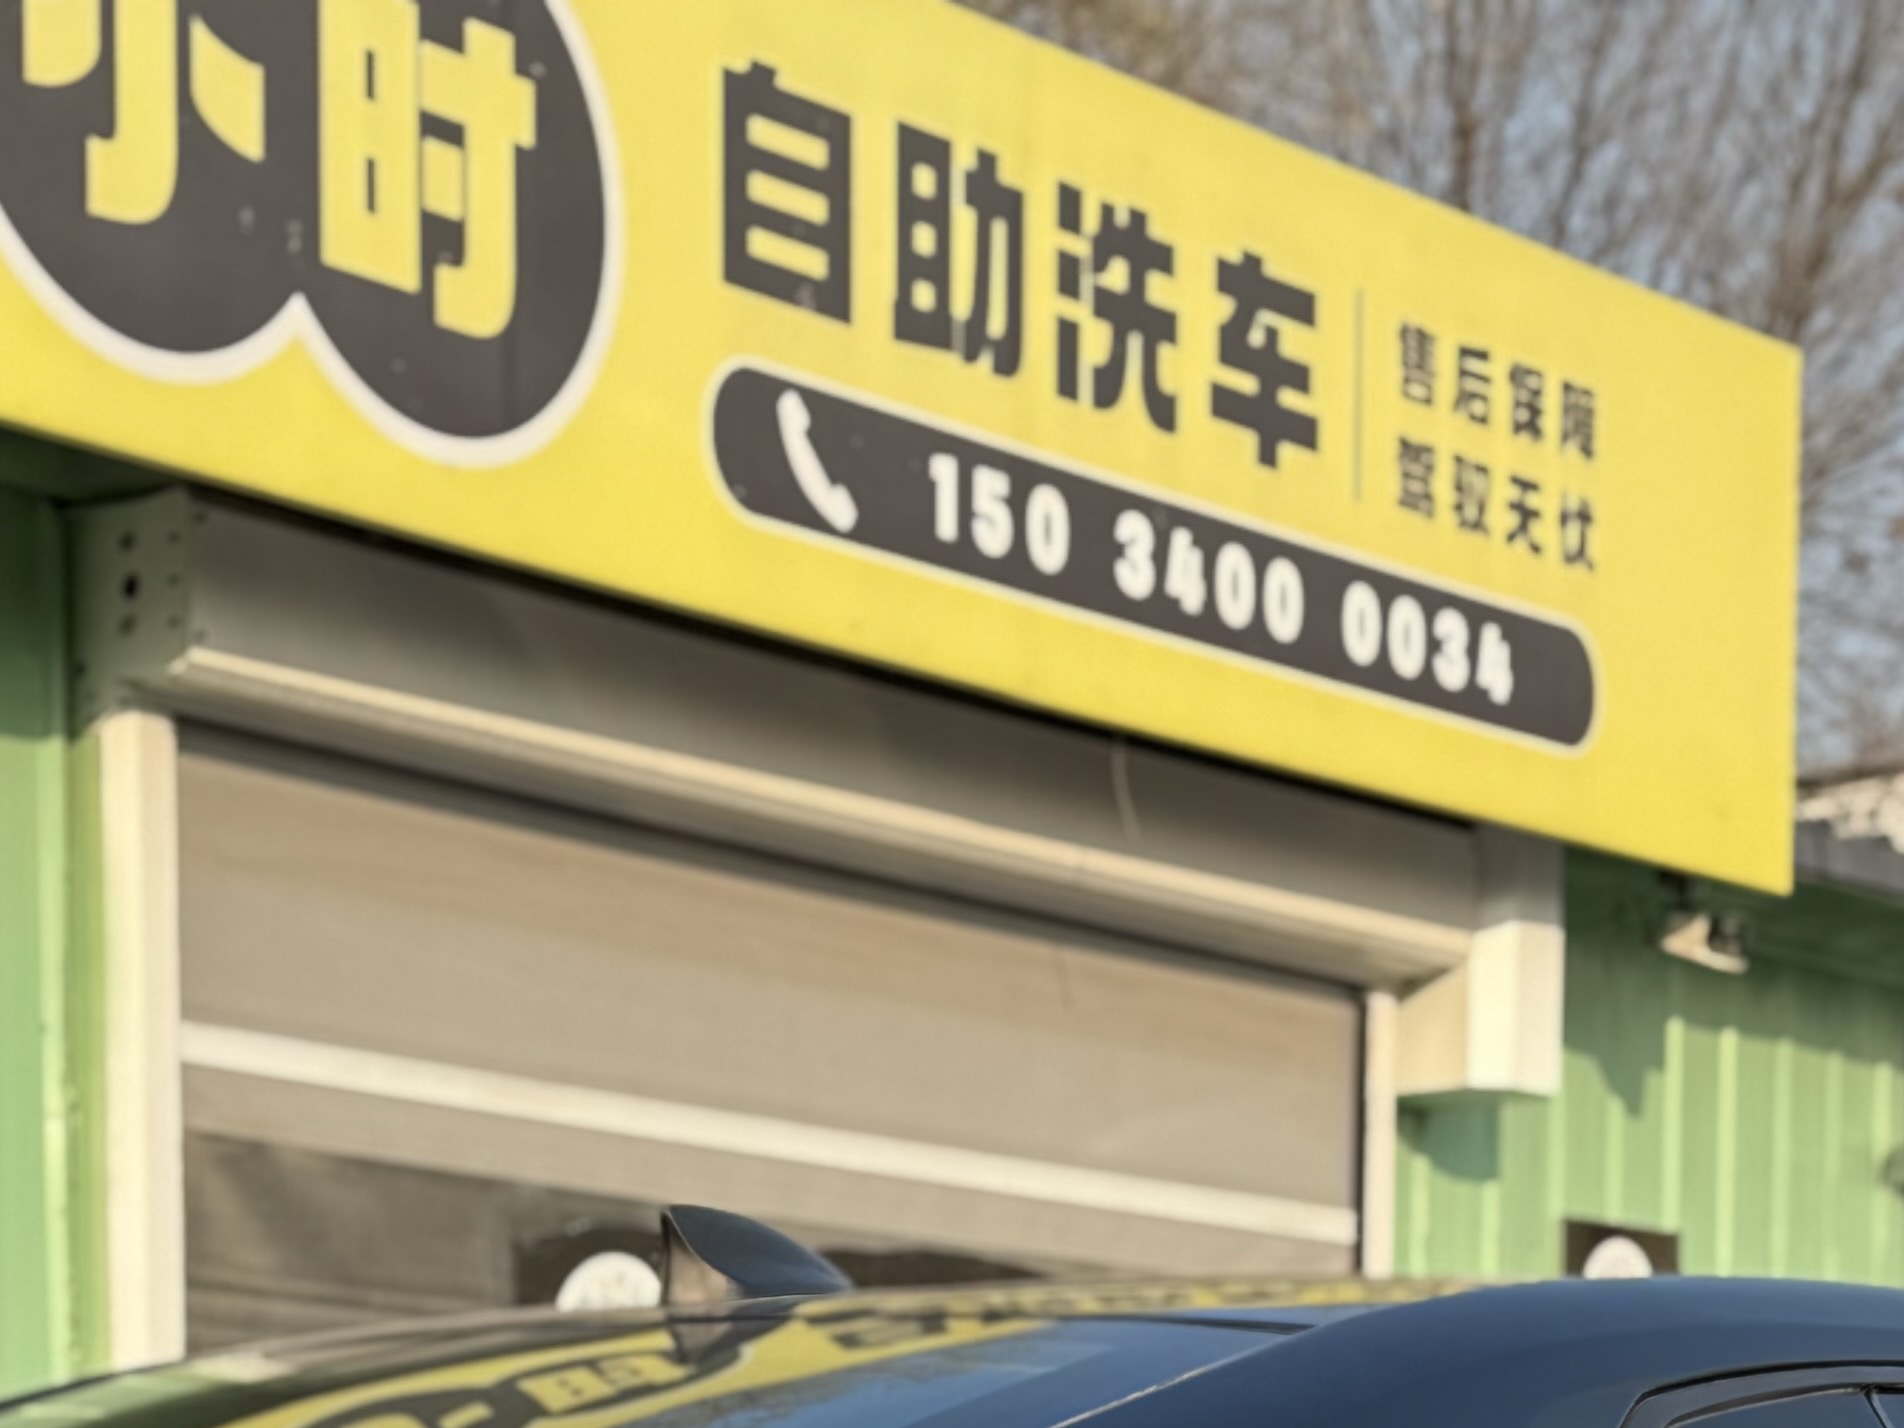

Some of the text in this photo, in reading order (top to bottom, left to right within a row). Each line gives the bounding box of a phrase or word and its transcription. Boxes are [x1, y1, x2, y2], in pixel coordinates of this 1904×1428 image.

[722, 60, 1319, 470] 自助洗车
[930, 453, 1515, 704] 150 3400 0034
